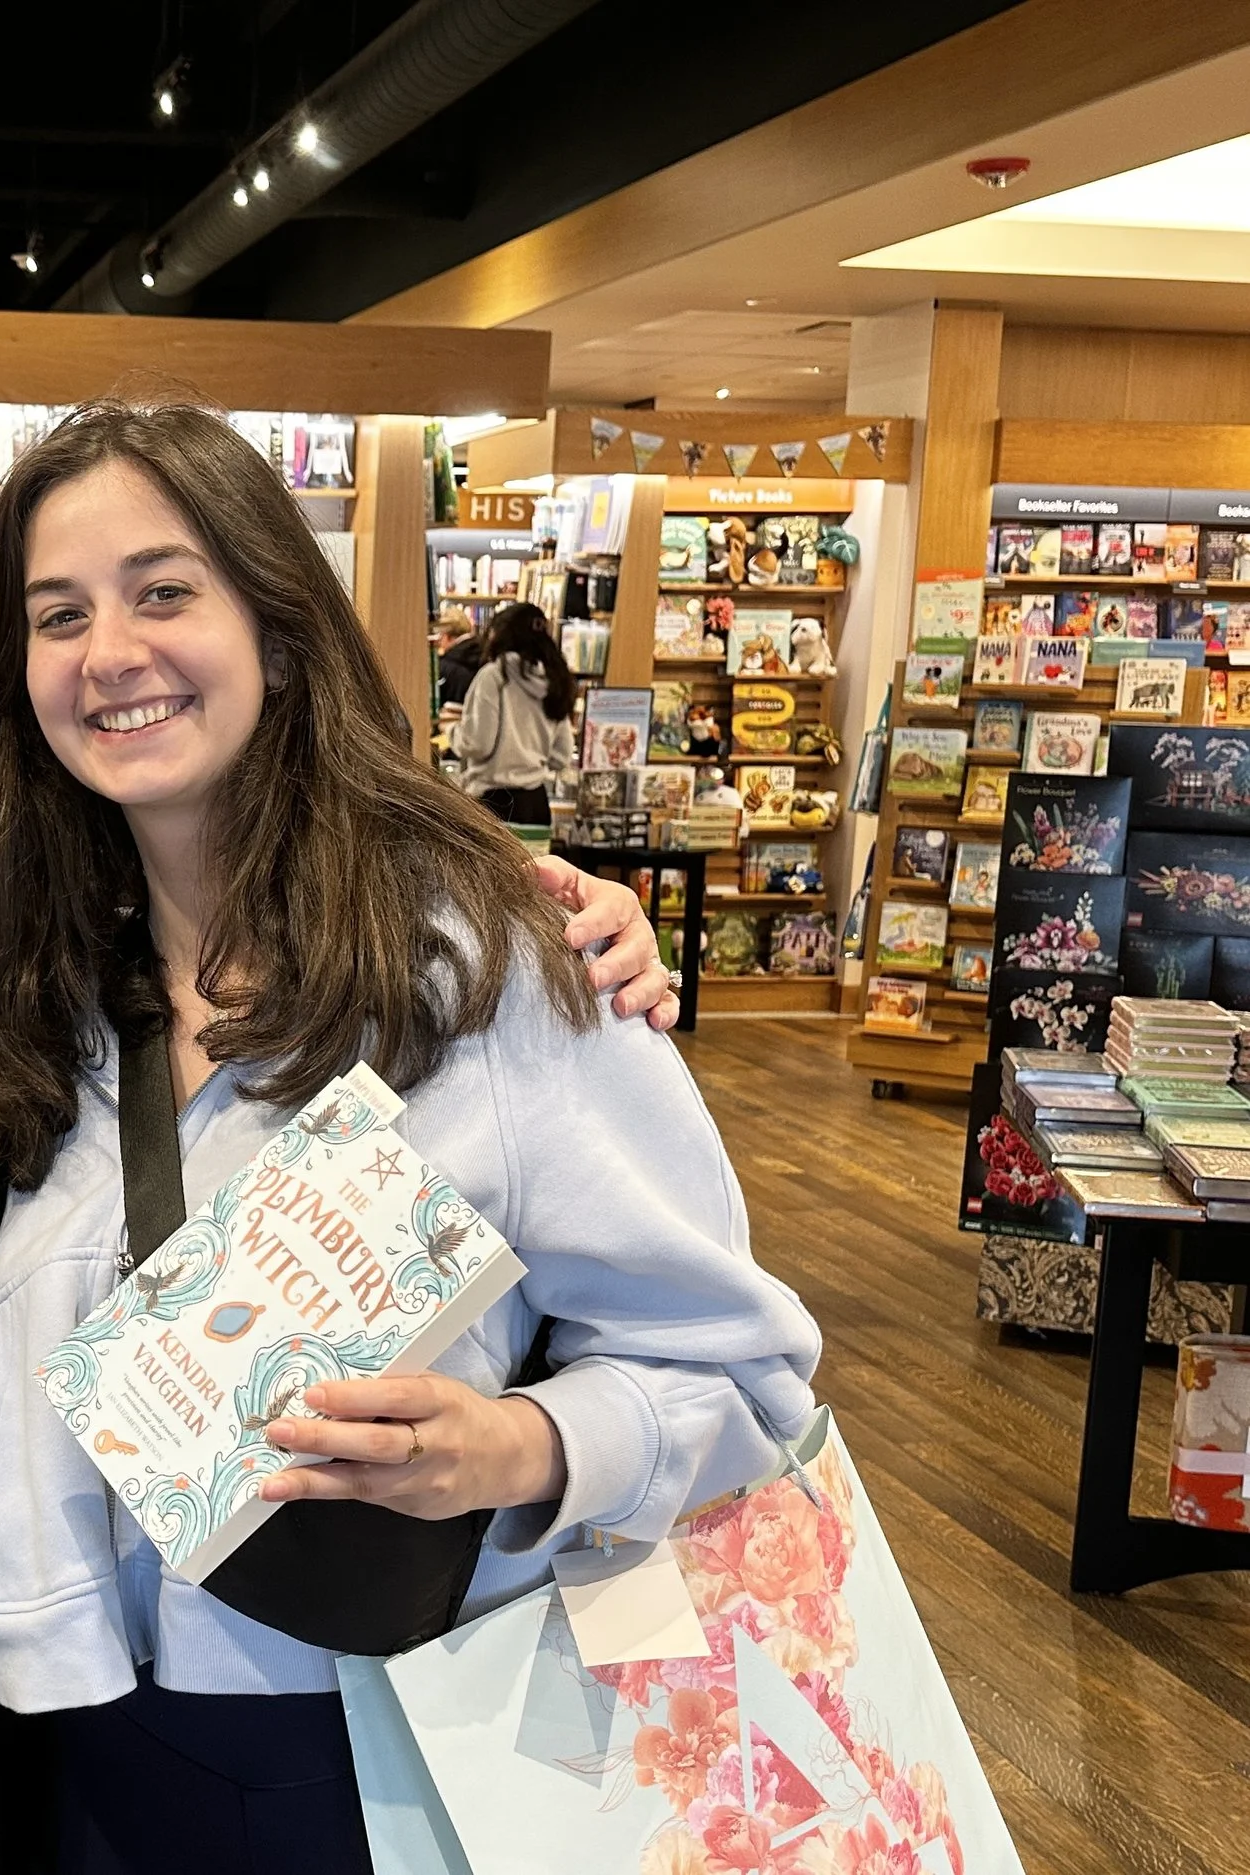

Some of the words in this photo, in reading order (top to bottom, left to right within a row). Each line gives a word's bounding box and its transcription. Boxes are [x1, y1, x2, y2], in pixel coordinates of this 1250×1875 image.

[471, 496, 527, 521] HIS
[709, 487, 753, 504] Picture
[756, 487, 794, 504] Books
[1018, 498, 1073, 513] Bookseller
[1074, 500, 1119, 514] Favorites
[337, 1178, 373, 1216] THE
[237, 1206, 344, 1332] WITCH
[243, 1165, 400, 1327] PLYMBURY
[133, 1342, 213, 1438] VAUGHAN
[156, 1327, 226, 1412] KENDRA
